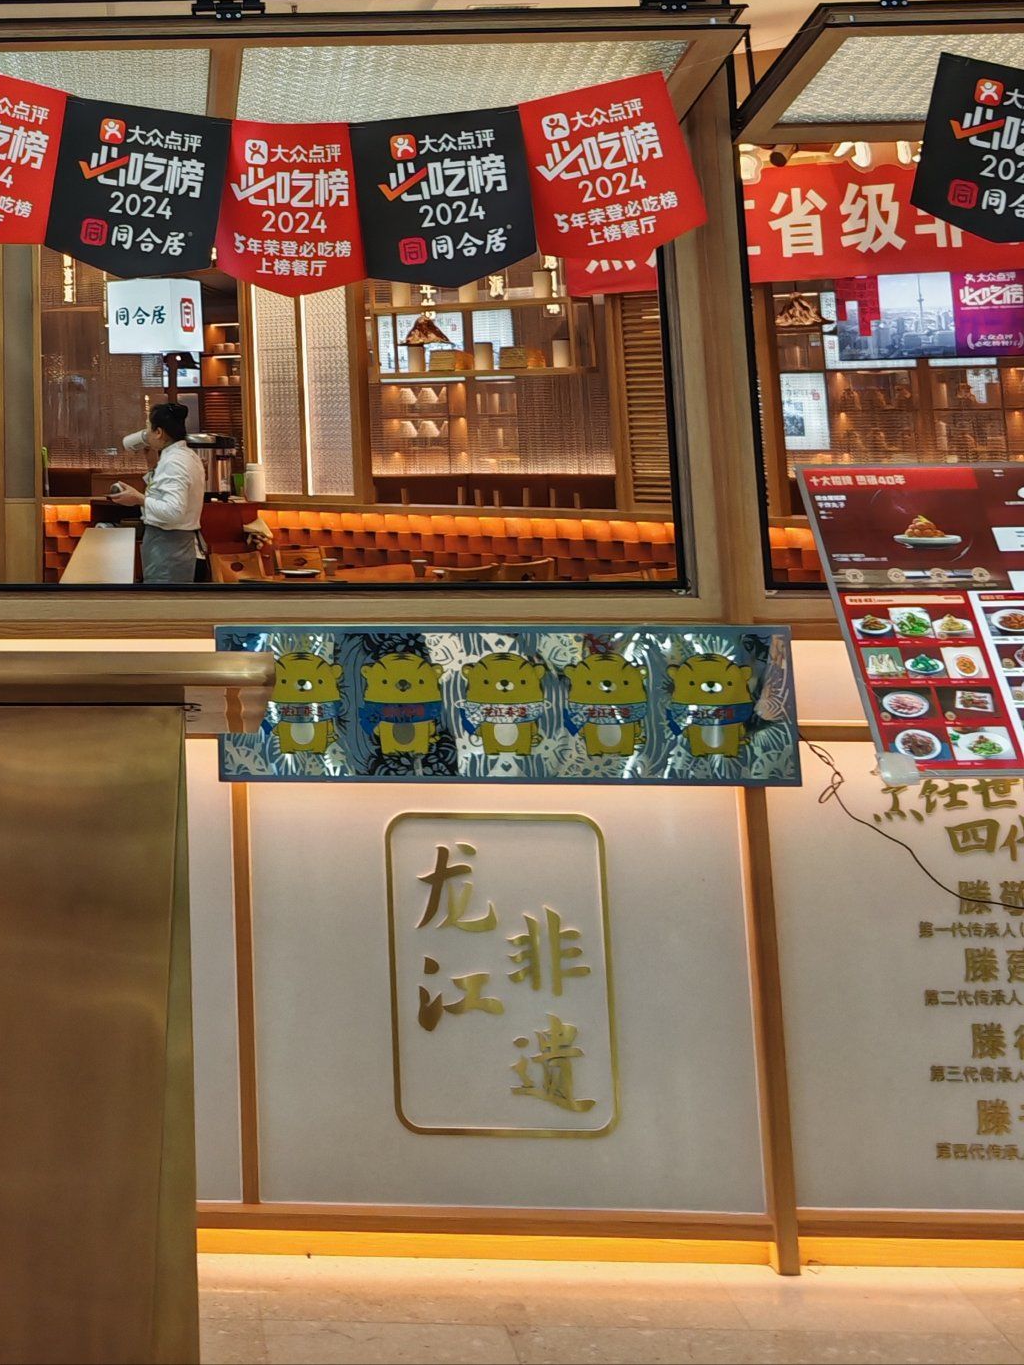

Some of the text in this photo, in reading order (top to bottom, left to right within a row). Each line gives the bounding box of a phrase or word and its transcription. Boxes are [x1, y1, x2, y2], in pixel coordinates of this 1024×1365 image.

[570, 98, 644, 132] 大众点评
[126, 125, 203, 153] 大众点评
[270, 144, 342, 164] 大众点评
[418, 128, 495, 155] 大众点评
[535, 121, 663, 182] 必吃榜
[78, 145, 206, 199] 必吃榜
[230, 166, 350, 208] 必吃榜
[377, 153, 508, 202] 必吃榜
[577, 167, 647, 203] 2024
[108, 191, 173, 220] 2024
[418, 197, 486, 228] 2024
[552, 190, 679, 234] 5年荣登必吃榜
[744, 183, 966, 257] 省级
[261, 209, 327, 234] 2024
[586, 215, 657, 246] 上榜餐厅
[111, 224, 186, 256] 同合居
[233, 232, 352, 258] 5年荣登必吃榜
[431, 227, 508, 260] 同合居
[256, 257, 327, 277] 上榜餐厅
[115, 305, 166, 327] 同合居
[936, 1141, 1024, 1161] 第四代传承
